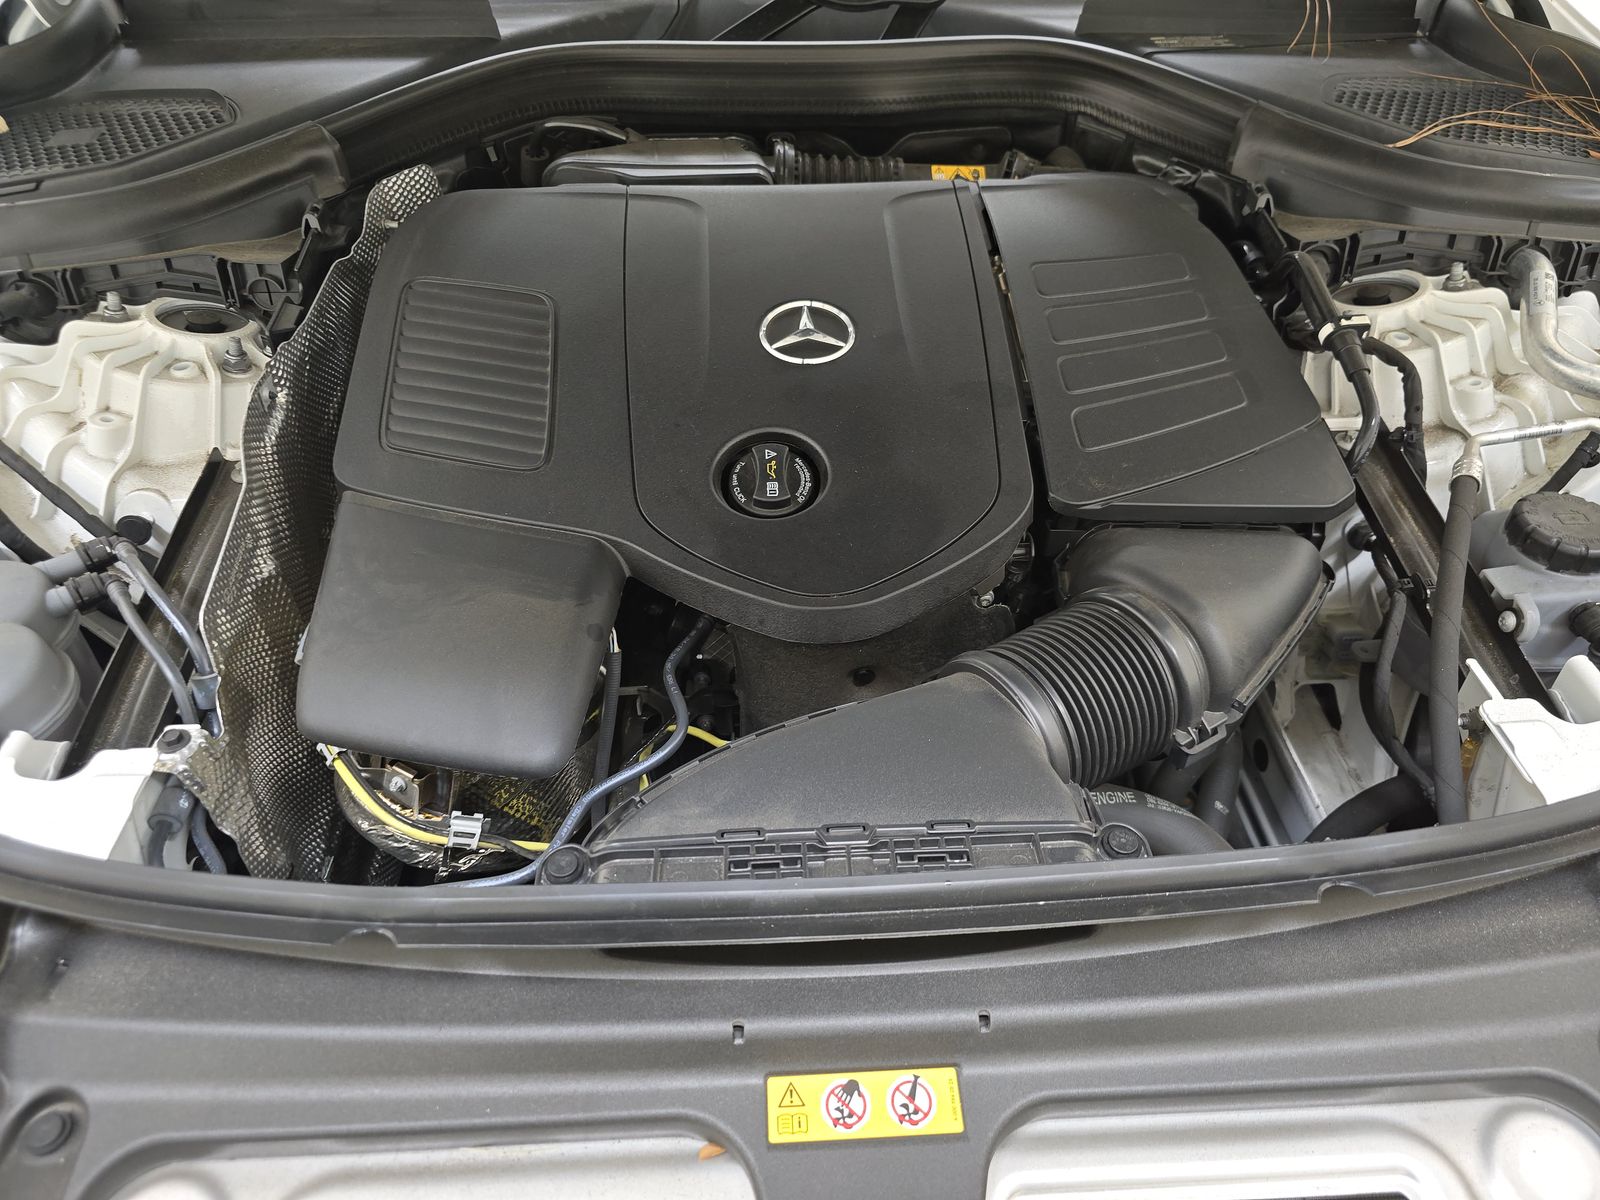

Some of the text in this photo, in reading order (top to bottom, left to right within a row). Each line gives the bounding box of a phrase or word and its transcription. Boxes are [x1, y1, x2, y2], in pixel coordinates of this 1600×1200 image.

[735, 461, 746, 473] Turn
[794, 457, 812, 496] Mercedes-Benz
[733, 487, 747, 503] CLICK
[1090, 791, 1136, 805] ENGINE
